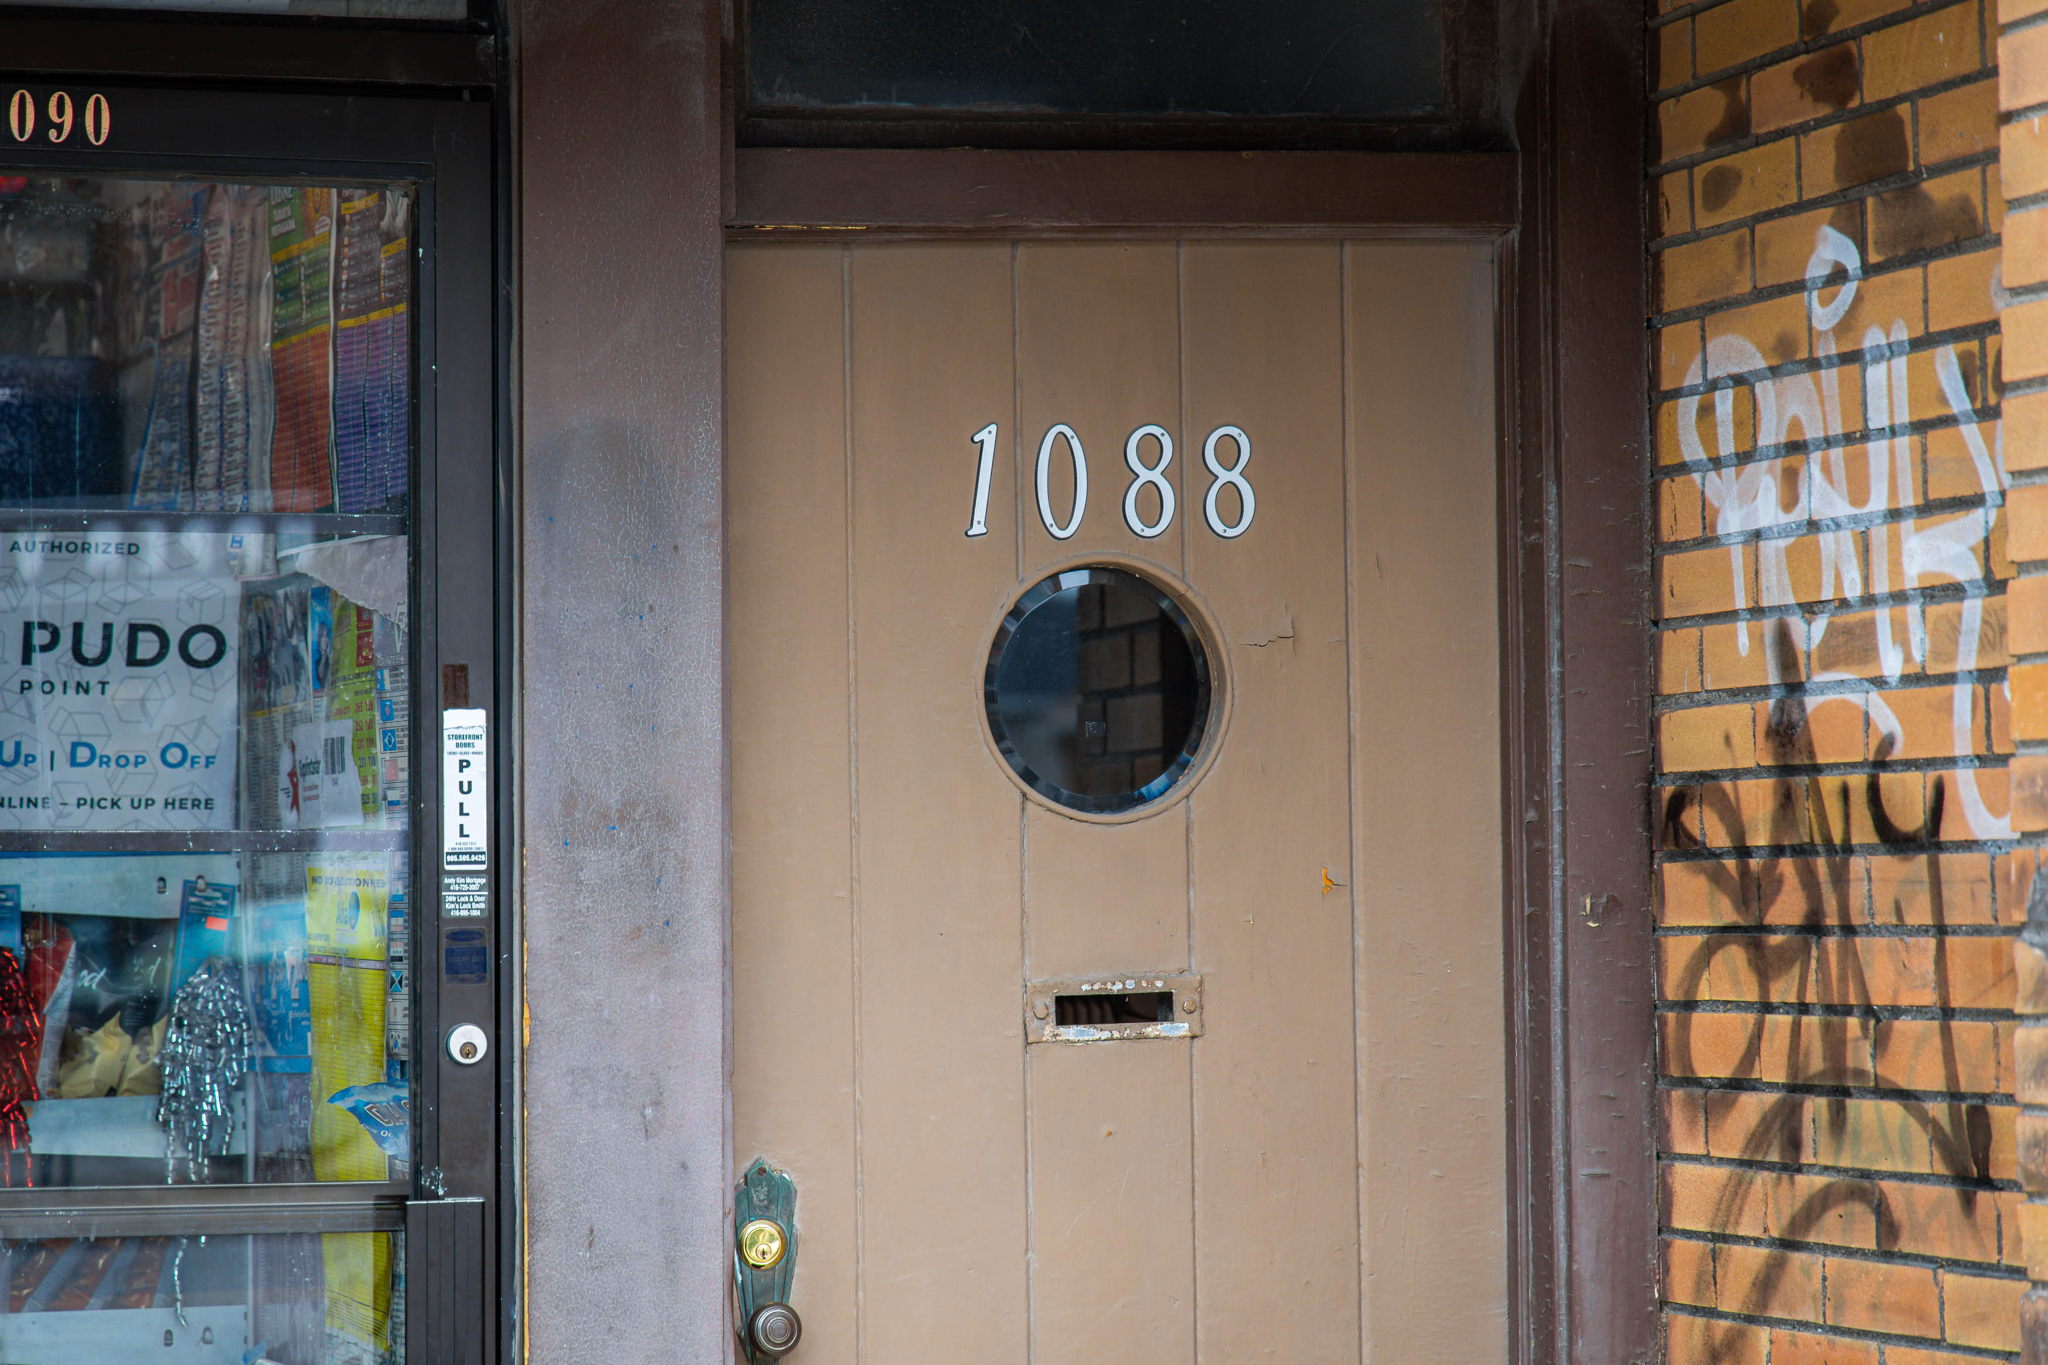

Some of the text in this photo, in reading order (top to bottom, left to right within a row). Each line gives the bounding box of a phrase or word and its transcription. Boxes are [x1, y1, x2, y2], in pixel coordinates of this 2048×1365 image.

[10, 89, 110, 146] 090
[965, 423, 1256, 541] 1088
[9, 540, 141, 556] AUTHORIZED
[21, 621, 228, 670] PUDO
[20, 680, 110, 696] POINT
[76, 797, 123, 810] PICK
[131, 797, 156, 810] UP
[164, 797, 215, 811] HERE
[459, 759, 472, 838] PULL
[312, 875, 323, 885] NO
